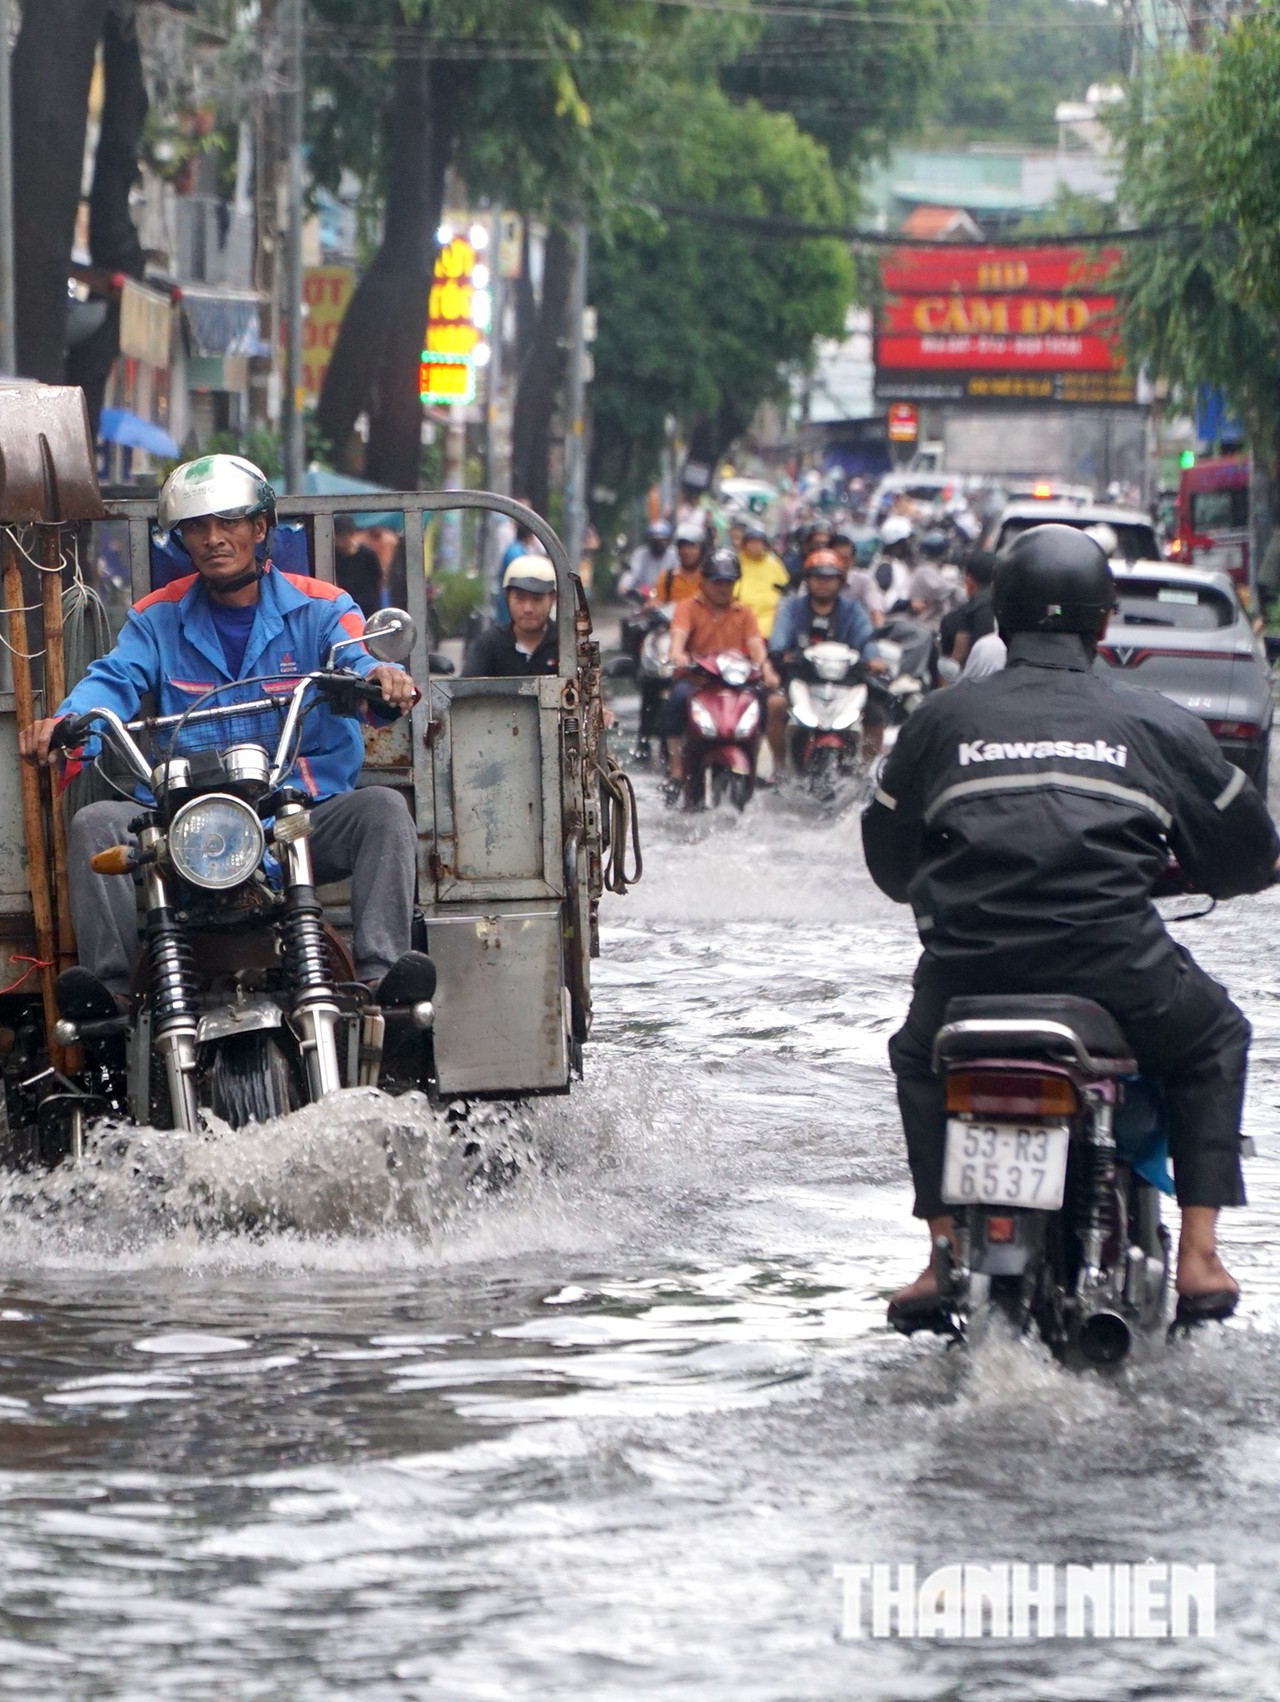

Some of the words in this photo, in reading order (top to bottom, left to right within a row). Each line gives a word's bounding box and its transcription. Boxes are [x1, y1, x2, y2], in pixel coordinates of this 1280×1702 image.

[958, 739, 1128, 768] Kawasaki
[963, 1125, 1048, 1163] 53-R3
[960, 1163, 1046, 1201] 6537
